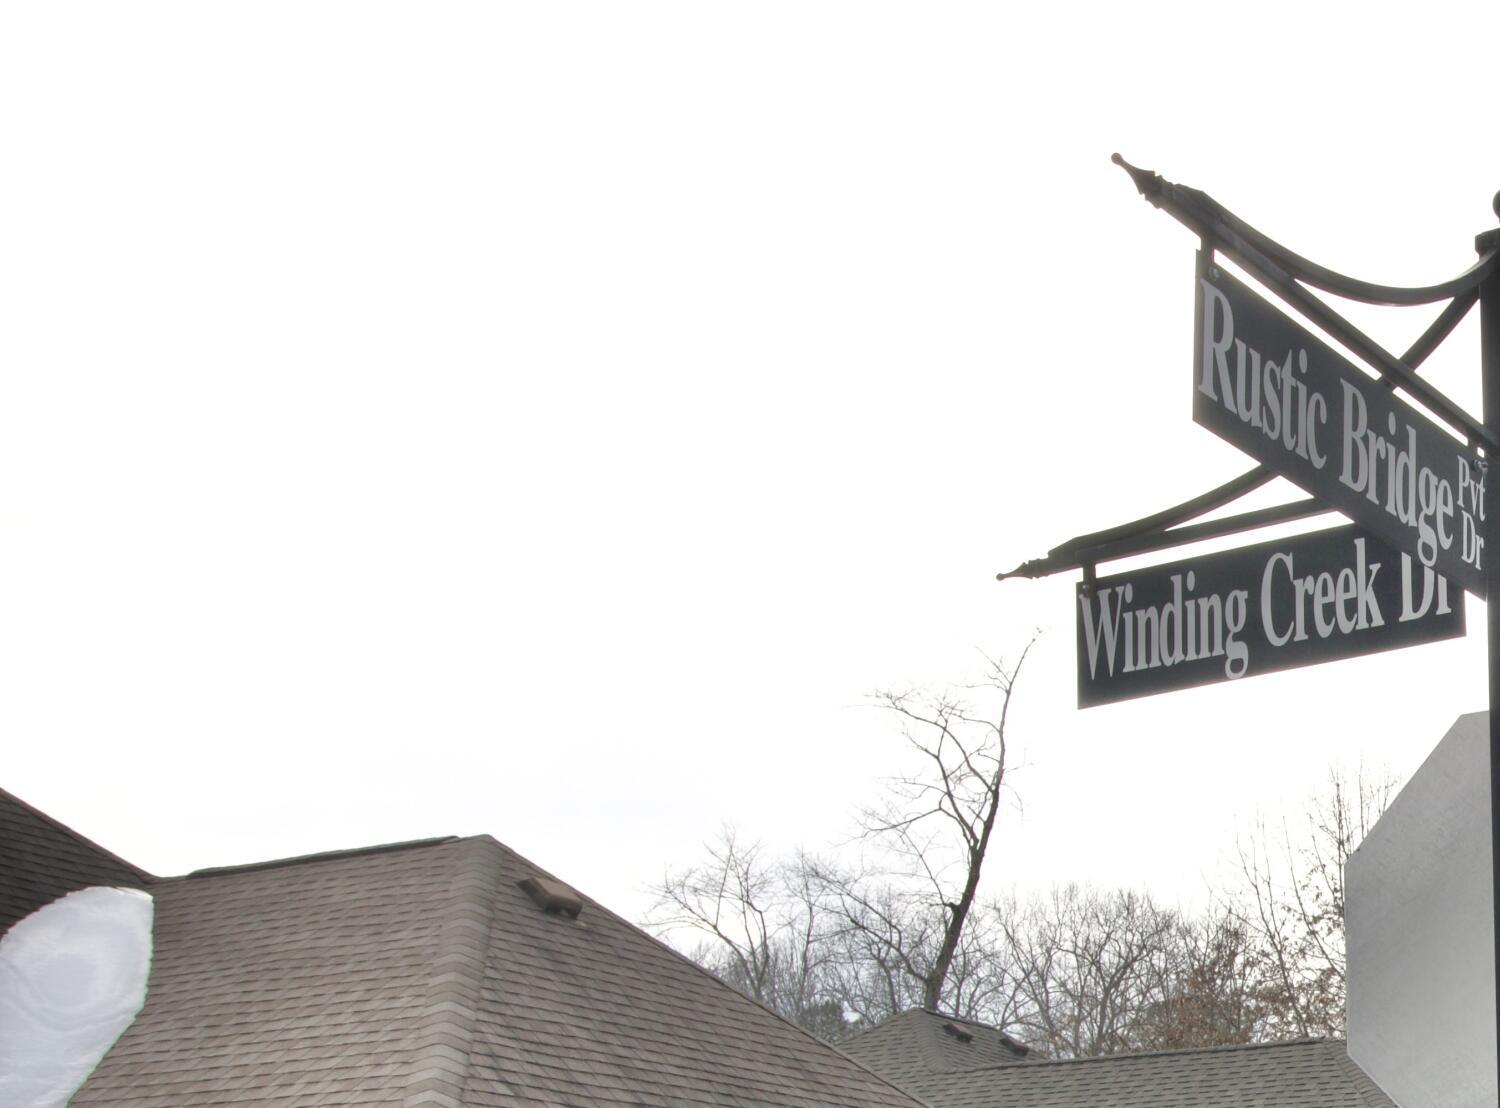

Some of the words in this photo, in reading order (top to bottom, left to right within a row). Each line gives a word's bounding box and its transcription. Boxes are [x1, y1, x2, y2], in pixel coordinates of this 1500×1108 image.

[1198, 277, 1328, 470] Rustic
[1338, 377, 1454, 567] Bridge
[1457, 455, 1486, 522] Pvt
[1461, 509, 1485, 571] Dr
[1079, 570, 1249, 680] Winding
[1260, 537, 1385, 647] Creek
